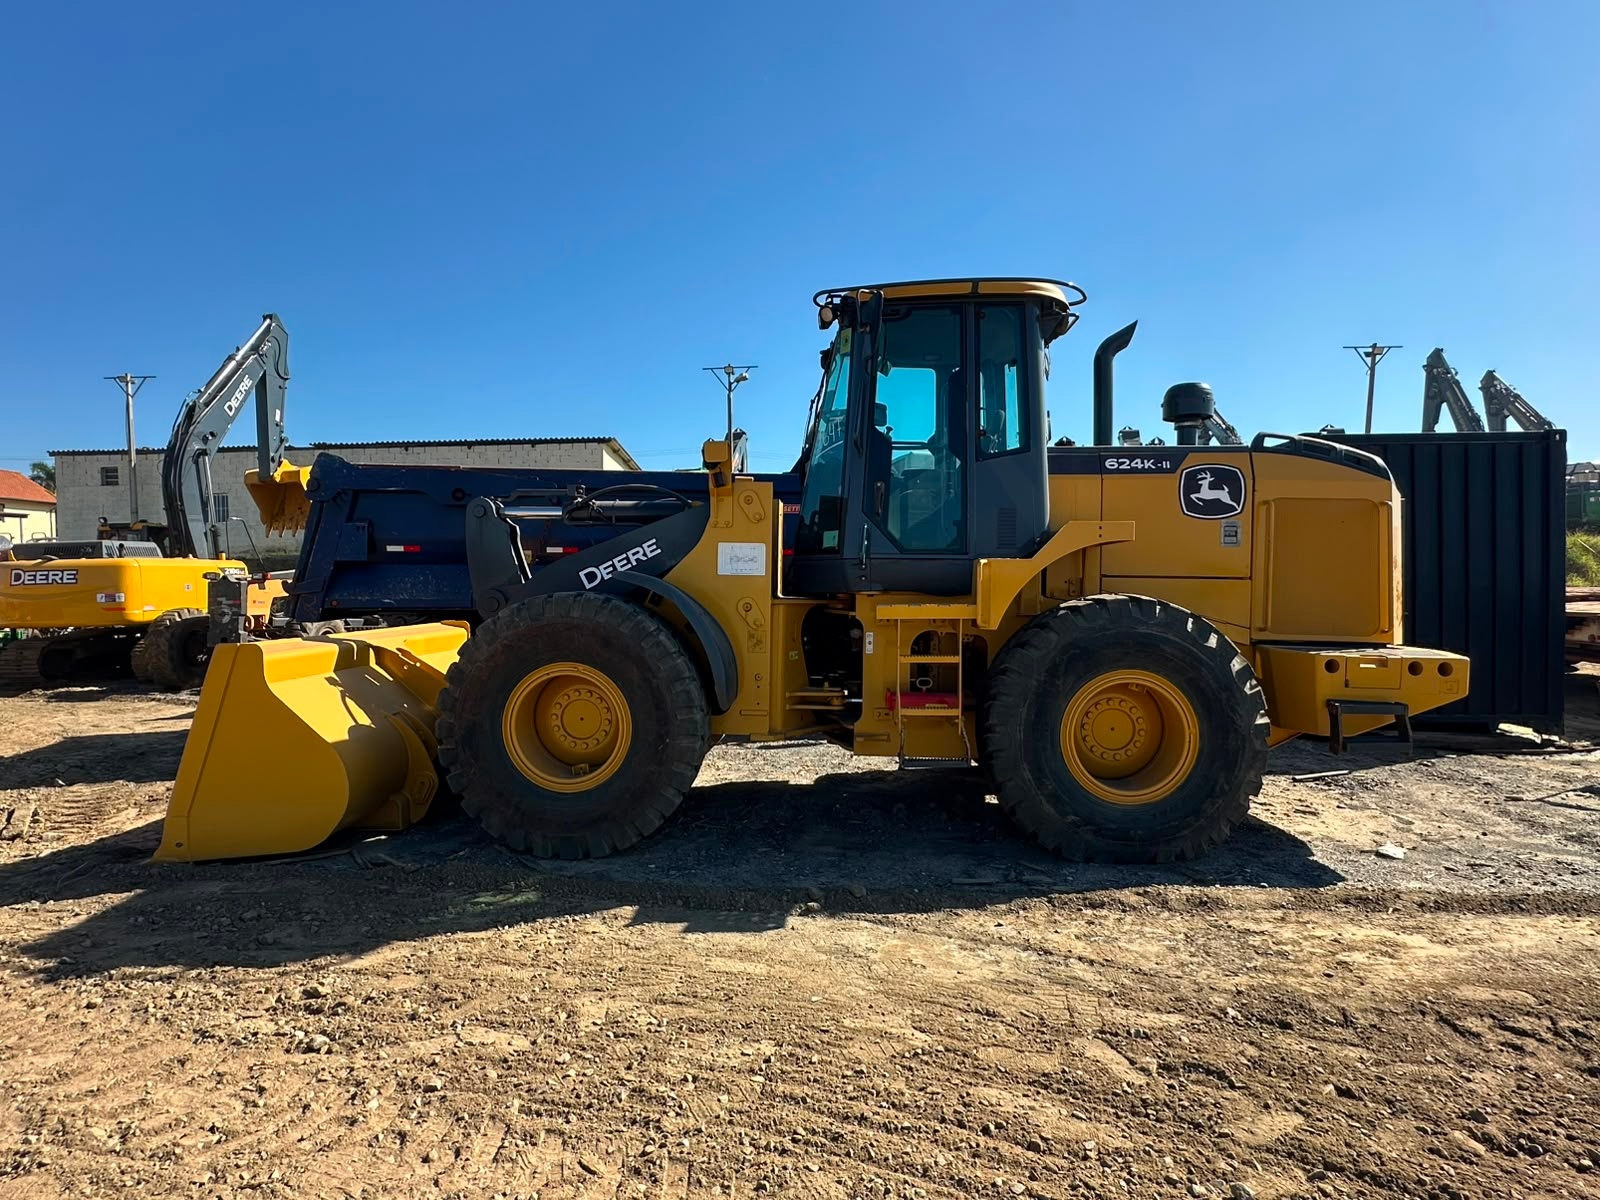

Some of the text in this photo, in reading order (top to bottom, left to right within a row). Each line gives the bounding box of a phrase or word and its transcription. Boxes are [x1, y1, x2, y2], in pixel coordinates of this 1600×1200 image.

[224, 374, 252, 416] DEERE
[11, 569, 77, 585] DEERE
[579, 538, 661, 589] DEERE
